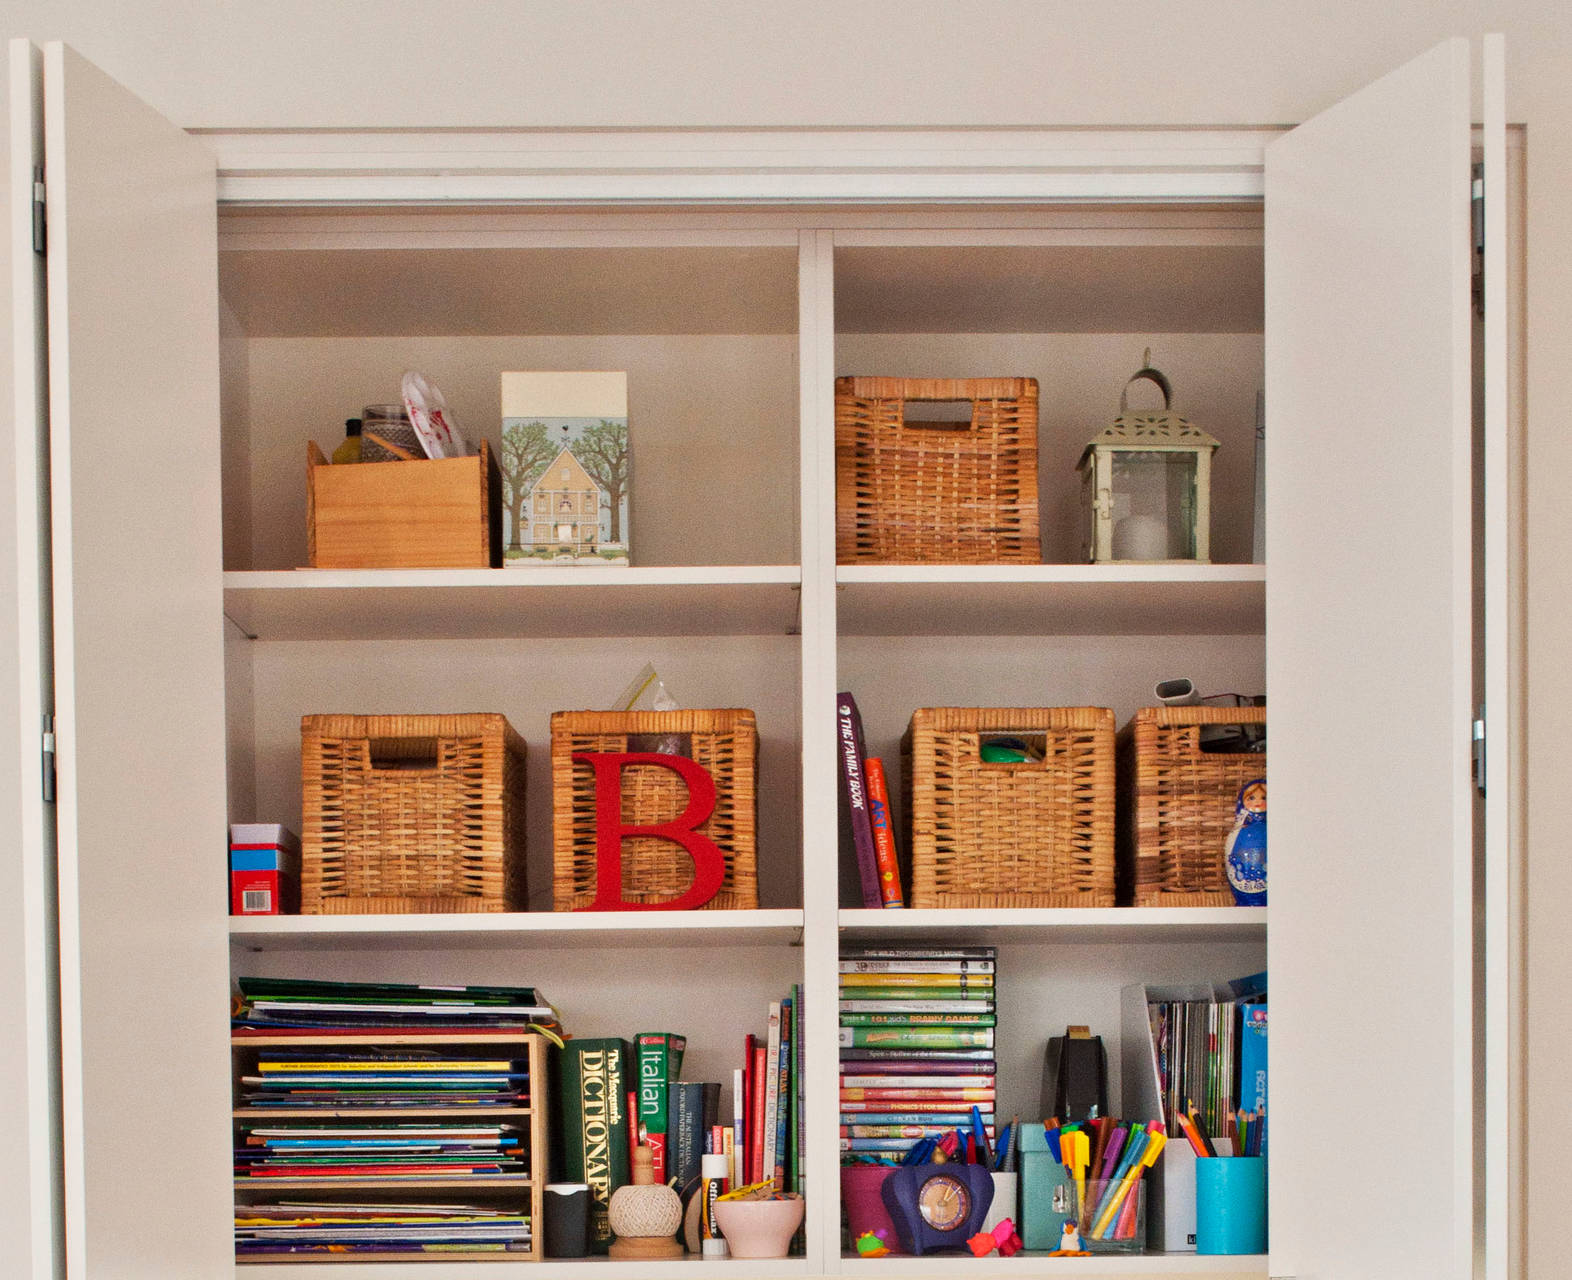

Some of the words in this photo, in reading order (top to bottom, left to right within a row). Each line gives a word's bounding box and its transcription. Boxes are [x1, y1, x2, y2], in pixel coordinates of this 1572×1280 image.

[840, 717, 853, 741] THE
[844, 741, 859, 782] FAMILY
[850, 780, 864, 811] BOOK
[871, 799, 888, 830] ART
[571, 752, 727, 912] B
[945, 1015, 979, 1023] GAMES
[607, 1049, 619, 1071] The
[641, 1051, 664, 1115] Italian
[769, 1068, 777, 1100] PICTURE
[779, 1069, 788, 1093] ATLAS
[608, 1072, 621, 1125] Macquarie
[767, 1102, 776, 1153] DICTIONARY
